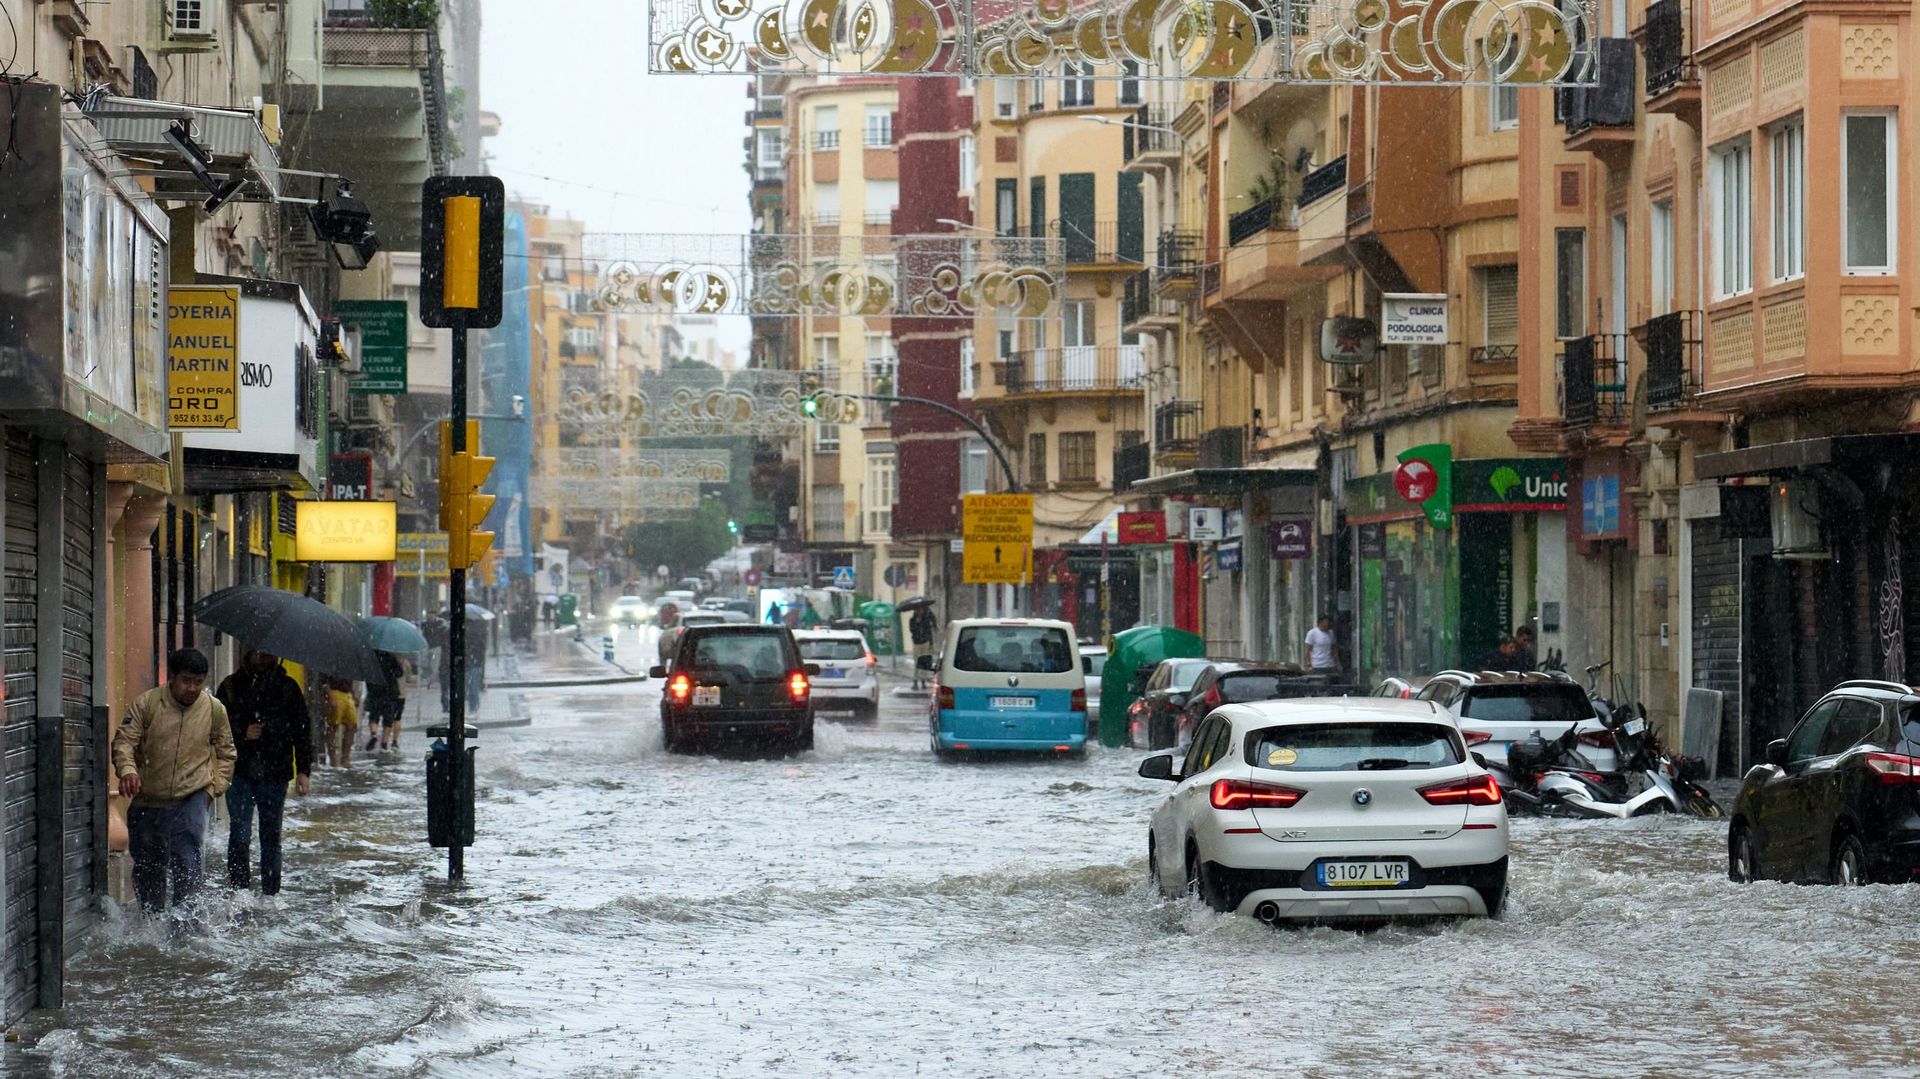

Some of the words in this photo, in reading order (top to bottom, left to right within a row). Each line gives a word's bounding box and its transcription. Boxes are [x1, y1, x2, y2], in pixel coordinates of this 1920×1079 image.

[1409, 306, 1444, 316] CLINICA
[1387, 323, 1444, 334] PODOLOGICA
[176, 386, 233, 395] COMPRA
[168, 397, 218, 410] ORO
[173, 414, 189, 423] 952
[190, 414, 200, 423] 61
[202, 414, 212, 423] 33
[214, 414, 224, 423] 45
[332, 484, 368, 500] IPA-T
[969, 496, 1029, 507] ATENCIÓN
[1433, 509, 1447, 522] 24
[302, 517, 391, 536] AVATAR
[964, 534, 1031, 543] RECOMENDADO
[1280, 830, 1307, 839] X2
[1327, 864, 1367, 880] 8107
[1374, 864, 1404, 880] LVR
